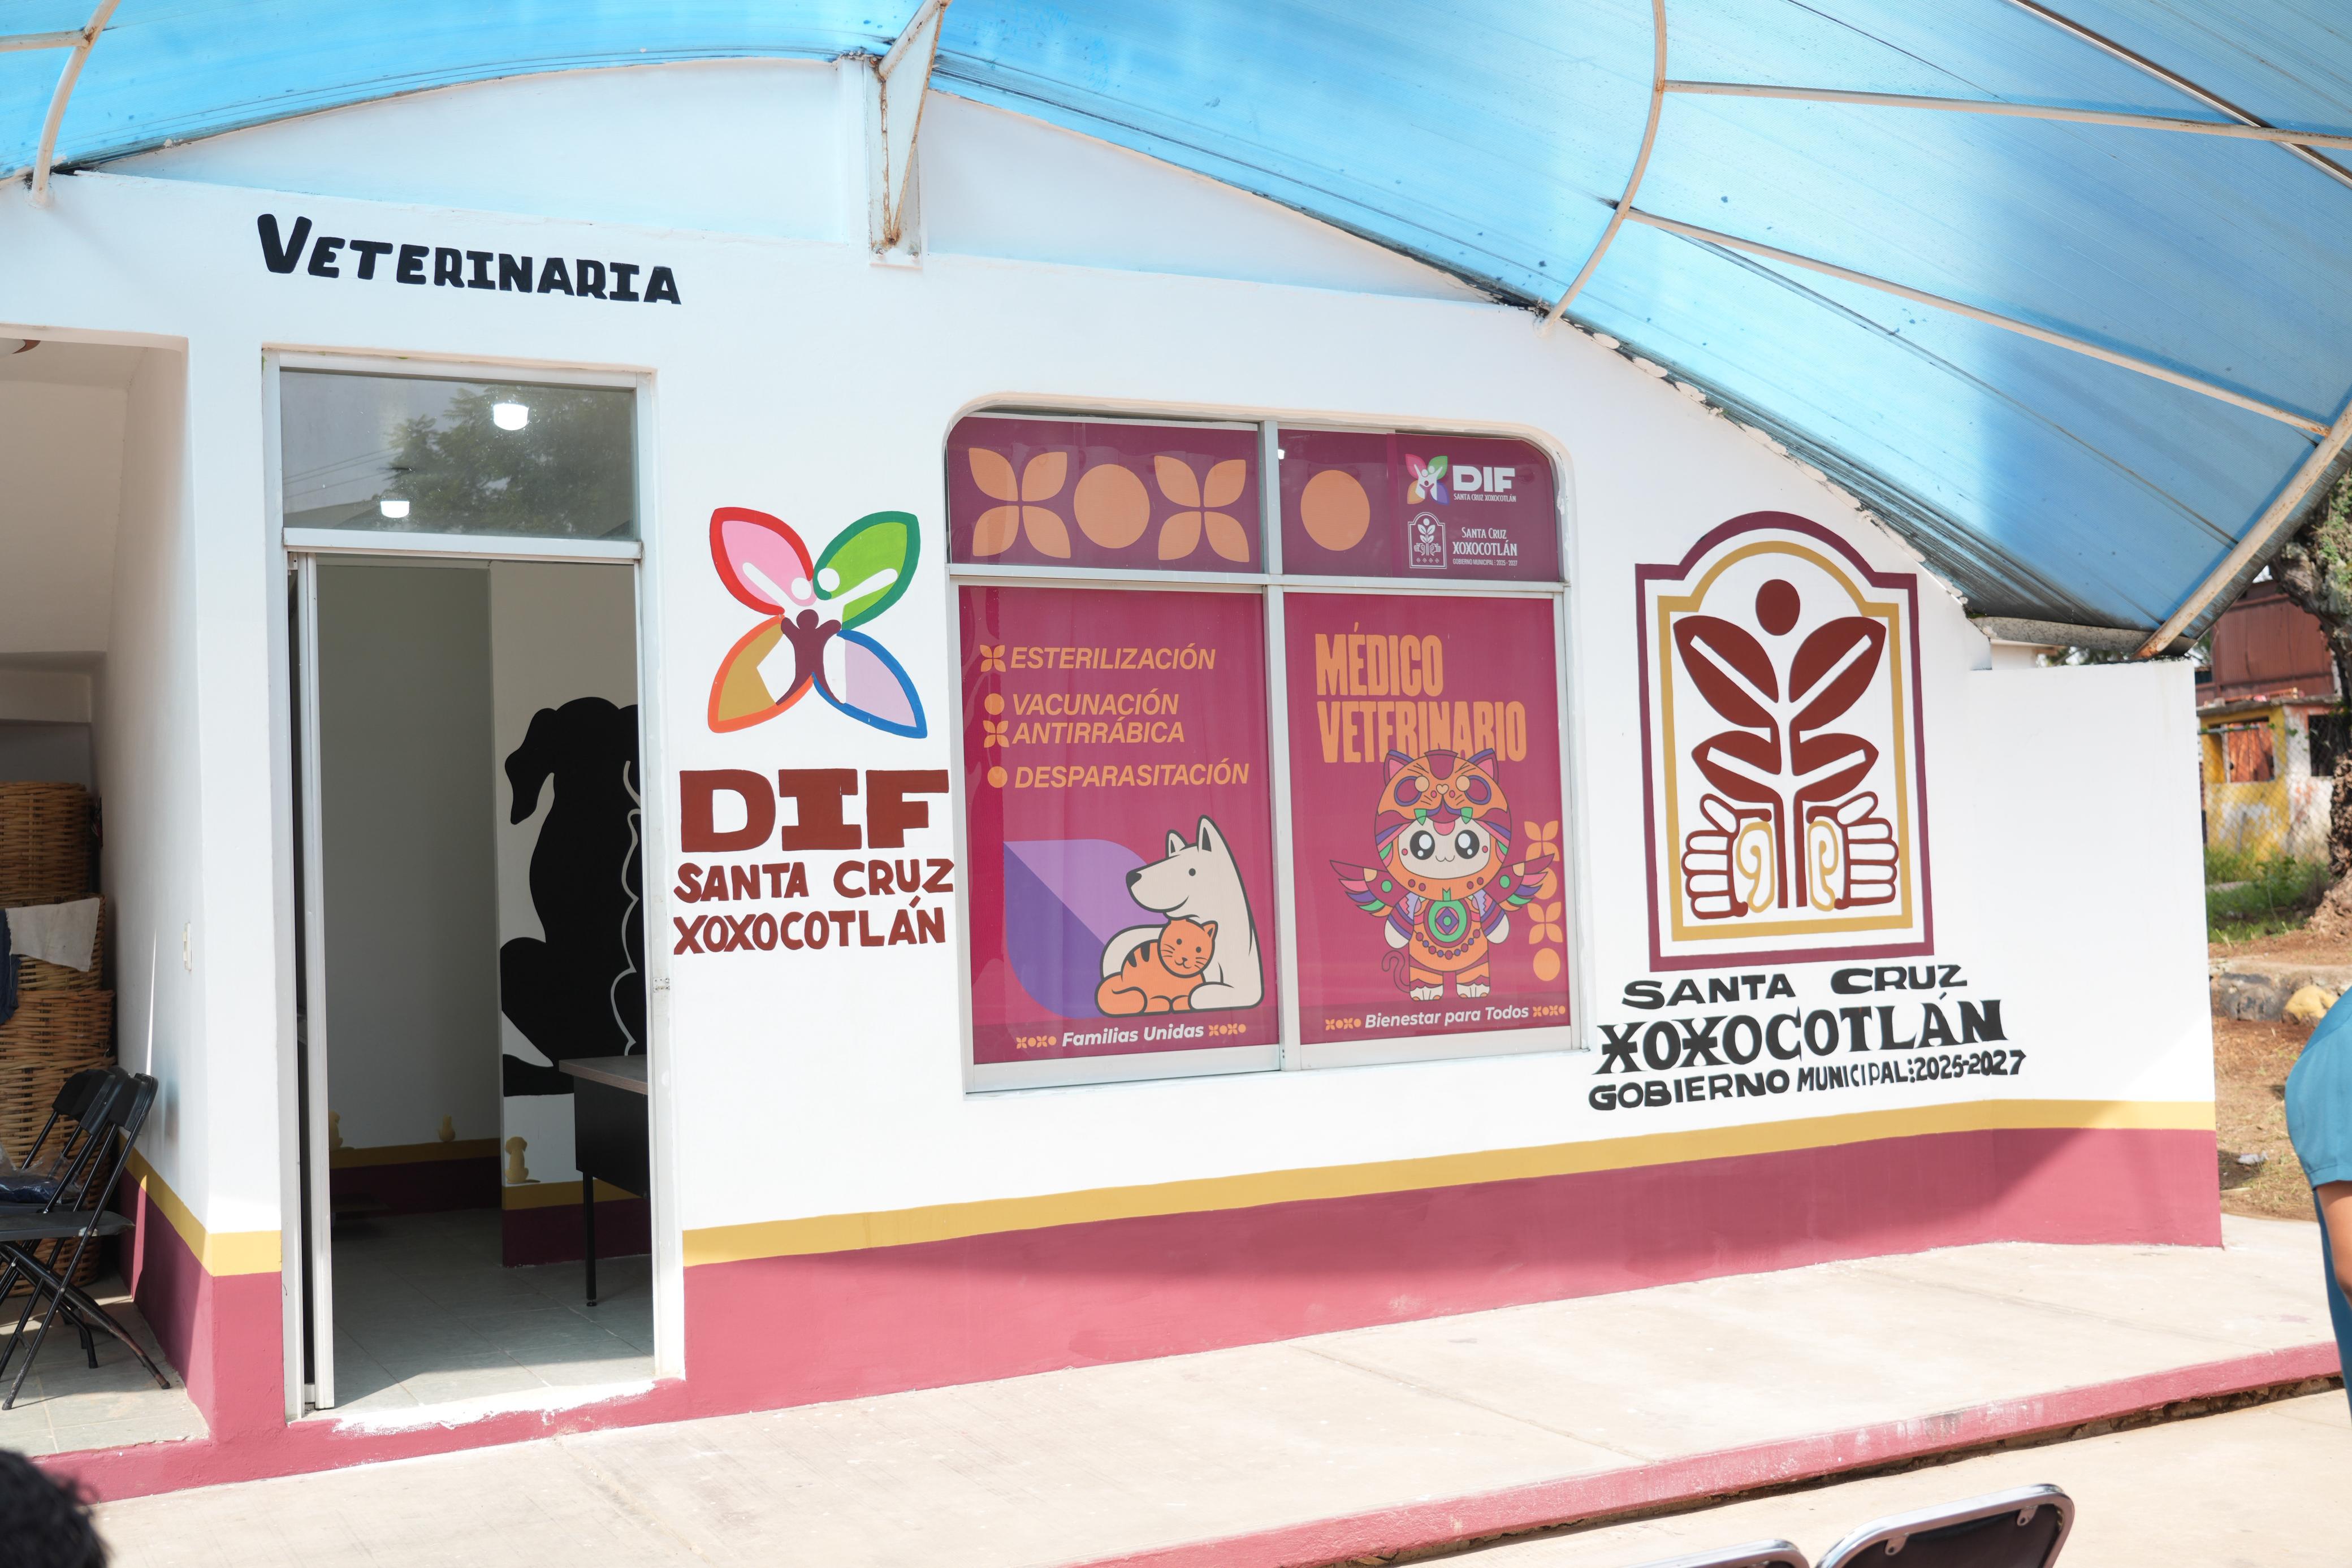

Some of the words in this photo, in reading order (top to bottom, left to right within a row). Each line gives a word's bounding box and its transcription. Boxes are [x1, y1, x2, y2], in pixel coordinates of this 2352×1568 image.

[257, 214, 682, 305] VETERINARIA
[1452, 465, 1515, 492] DIF
[1452, 540, 1517, 556] XOXOCOTLÁN
[1010, 643, 1216, 670] ESTERILIZACIÓN
[1315, 622, 1443, 696] MÉDICO
[1013, 688, 1179, 716] VACUNACIÓN
[1012, 717, 1185, 744] ANTIRRÁBICA
[1317, 701, 1527, 763] VETERINARIO
[1015, 758, 1250, 788] DESPARASITACIÓN
[680, 768, 949, 853] DIF
[673, 862, 810, 904] SANTA
[833, 859, 954, 898] CRUZ
[673, 895, 946, 955] XOXOCOTLÁN
[1621, 973, 1796, 1010] SANTA
[1830, 964, 1968, 995] CRUZ
[1062, 1027, 1138, 1047] Familias
[1143, 1024, 1204, 1041] Unidas
[1364, 1011, 1441, 1028] Bienestar
[1444, 1009, 1481, 1026] para
[1485, 1005, 1529, 1020] Todos
[1591, 992, 2008, 1075] XOXOCOTLÁN
[1588, 1069, 1790, 1111] GOBIERNO
